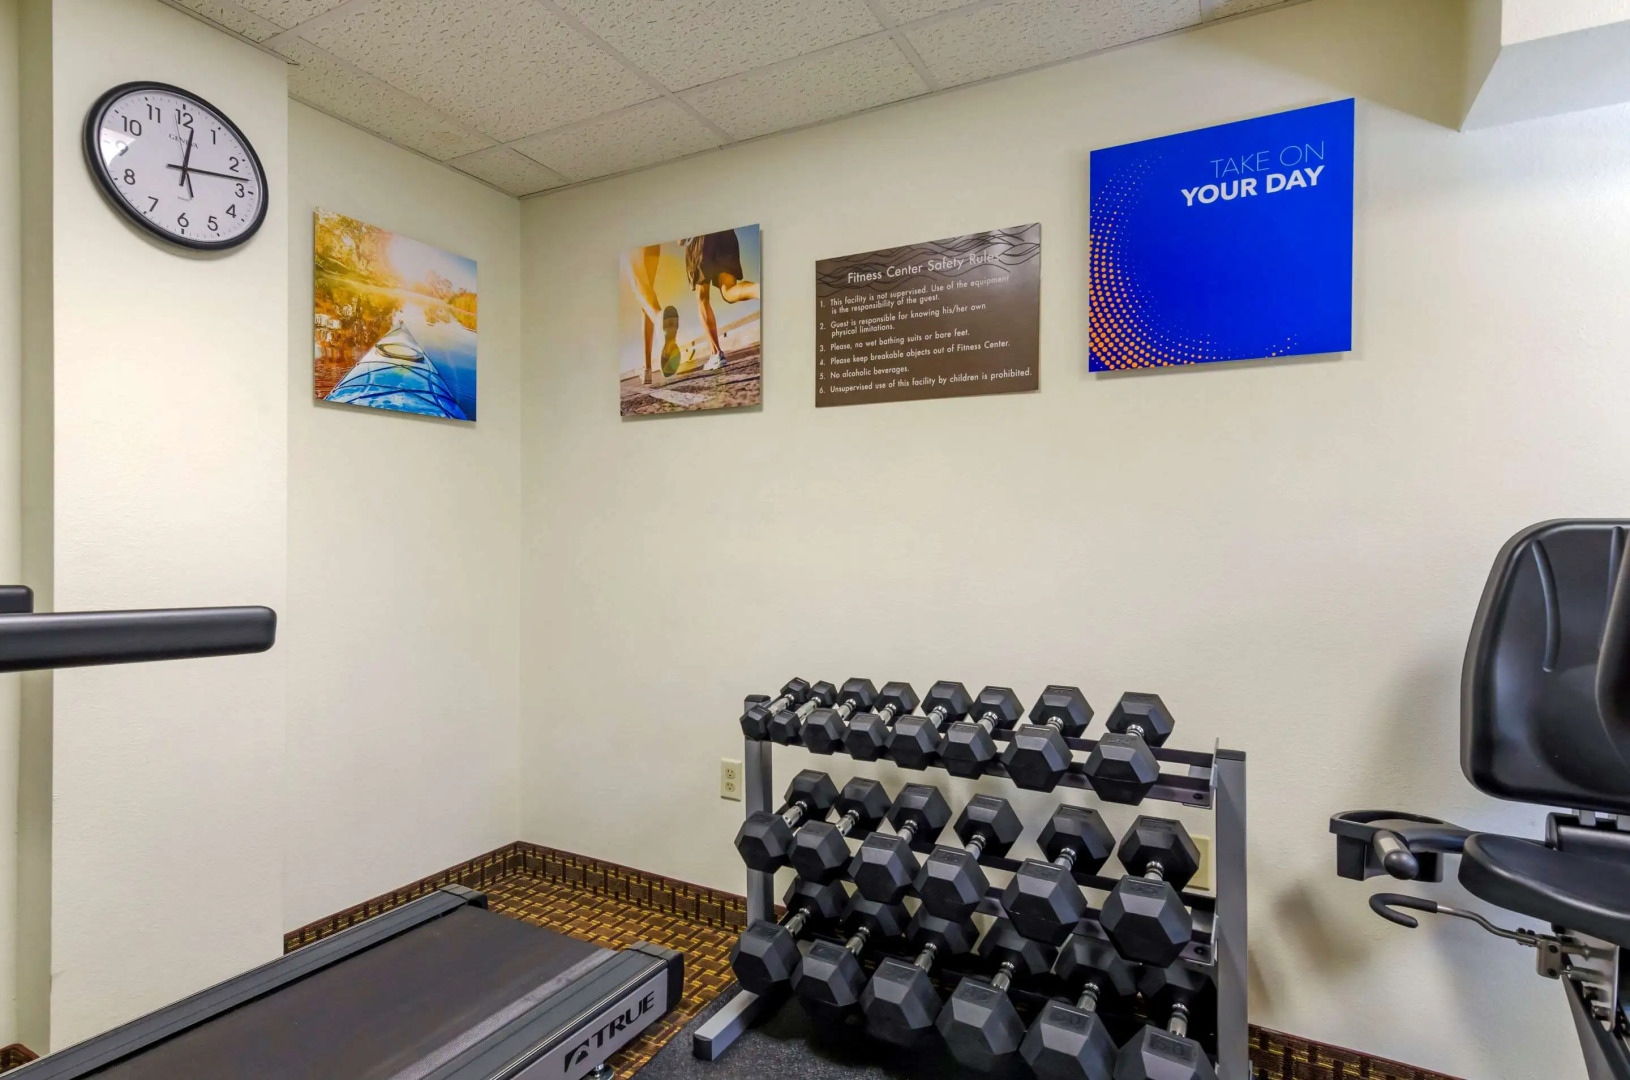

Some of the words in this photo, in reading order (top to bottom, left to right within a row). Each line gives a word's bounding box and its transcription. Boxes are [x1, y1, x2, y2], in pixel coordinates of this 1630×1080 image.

[146, 104, 161, 123] 11
[175, 109, 194, 130] 12
[122, 116, 142, 137] 10
[210, 129, 216, 145] 1
[229, 157, 239, 172] 2
[1210, 150, 1270, 178] TAKE
[1280, 140, 1325, 167] ON
[124, 168, 136, 185] 8
[235, 183, 245, 198] 3
[1180, 177, 1258, 207] YOUR
[1266, 165, 1326, 194] DAY
[148, 196, 159, 212] 7
[226, 204, 237, 218] 4
[177, 213, 189, 228] 6
[207, 216, 218, 232] 5
[847, 271, 882, 284] Fitness
[886, 265, 922, 278] Center
[927, 256, 964, 271] Safety
[969, 250, 1000, 265] Rules
[844, 295, 866, 304] facility
[946, 281, 954, 290] of
[970, 275, 1009, 287] equipment
[851, 300, 894, 312] responsibility
[897, 297, 904, 305] of
[920, 294, 940, 304] guest.
[859, 313, 896, 326] responsible
[911, 308, 940, 318] knowing
[942, 304, 968, 314] his/her
[831, 326, 857, 339] physical
[860, 324, 895, 333] limitations.
[879, 336, 904, 345] bathing
[907, 334, 922, 342] suits
[935, 331, 952, 339] bare
[954, 328, 970, 337] feet.
[852, 355, 868, 363] keep
[870, 350, 904, 360] breakable
[906, 349, 930, 358] objects
[947, 344, 954, 353] of
[956, 343, 981, 352] Fitness
[984, 340, 1010, 349] Center.
[830, 381, 873, 393] Unsupervised
[888, 379, 896, 388] of
[912, 376, 936, 386] facility
[938, 375, 947, 385] by
[950, 373, 979, 382] children
[990, 366, 1032, 381] prohibited.
[842, 368, 871, 378] alcoholic
[873, 366, 909, 375] beverages.
[591, 990, 654, 1049] TRUE
